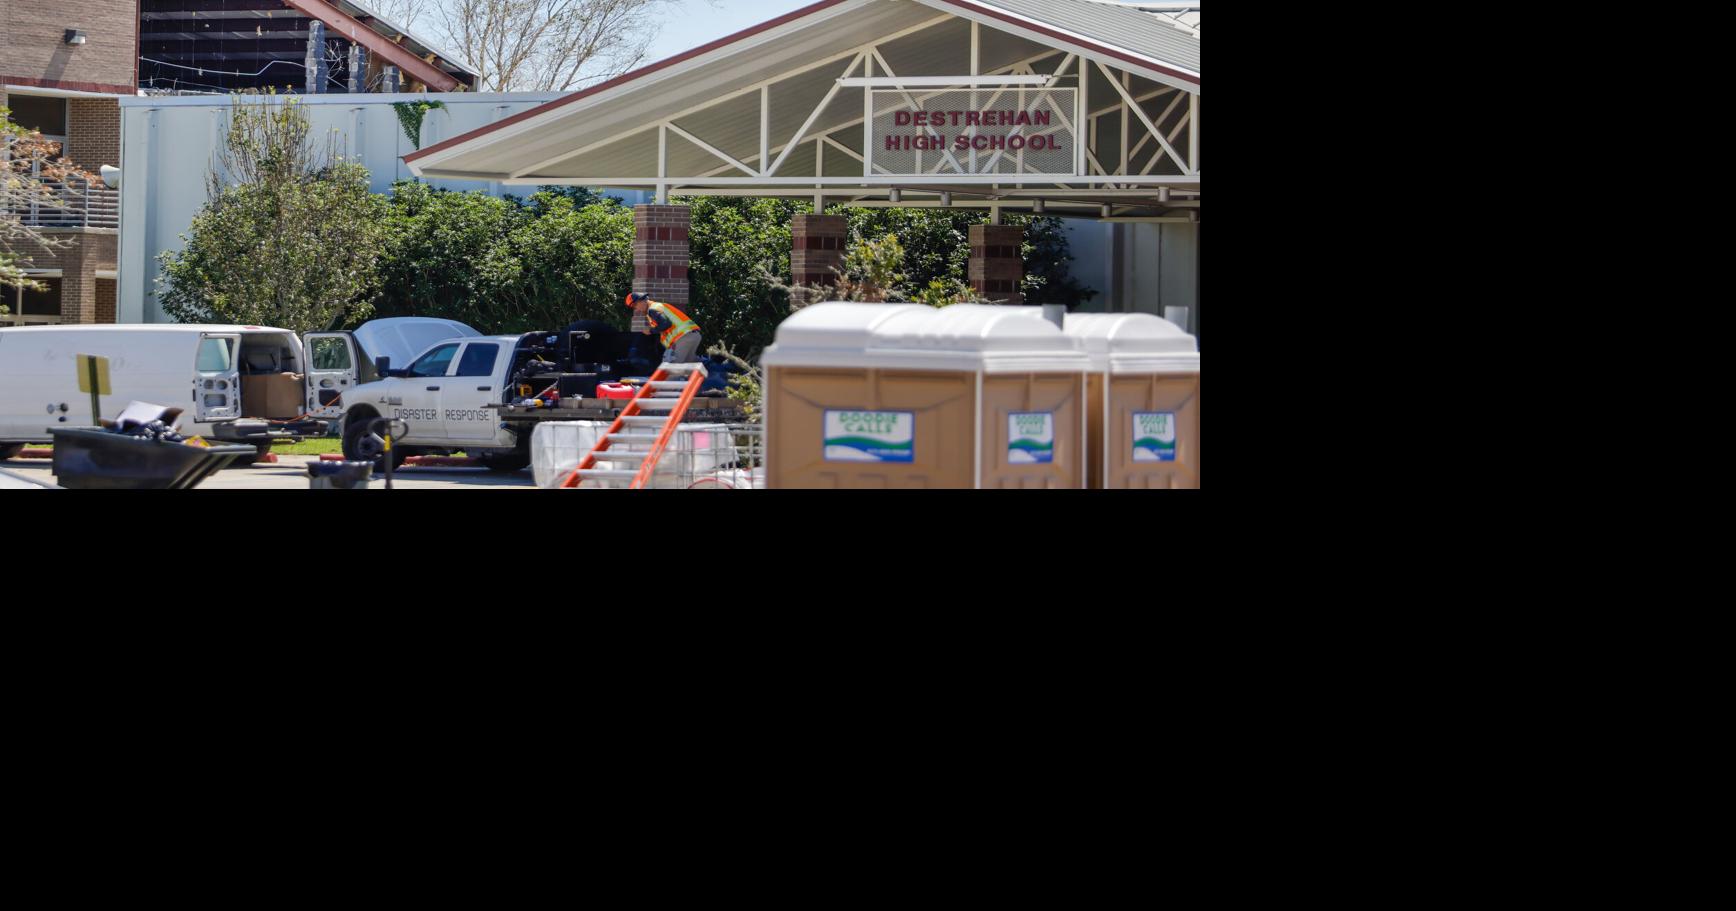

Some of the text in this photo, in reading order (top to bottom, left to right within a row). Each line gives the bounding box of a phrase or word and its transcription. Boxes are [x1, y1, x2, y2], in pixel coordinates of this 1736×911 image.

[894, 110, 1051, 127] DESTREHAN
[884, 134, 1062, 151] HIGH SCHOOL
[394, 408, 490, 421] DISASTER RESPONSE
[839, 412, 897, 424] DOODIE
[844, 422, 892, 434] CALLS
